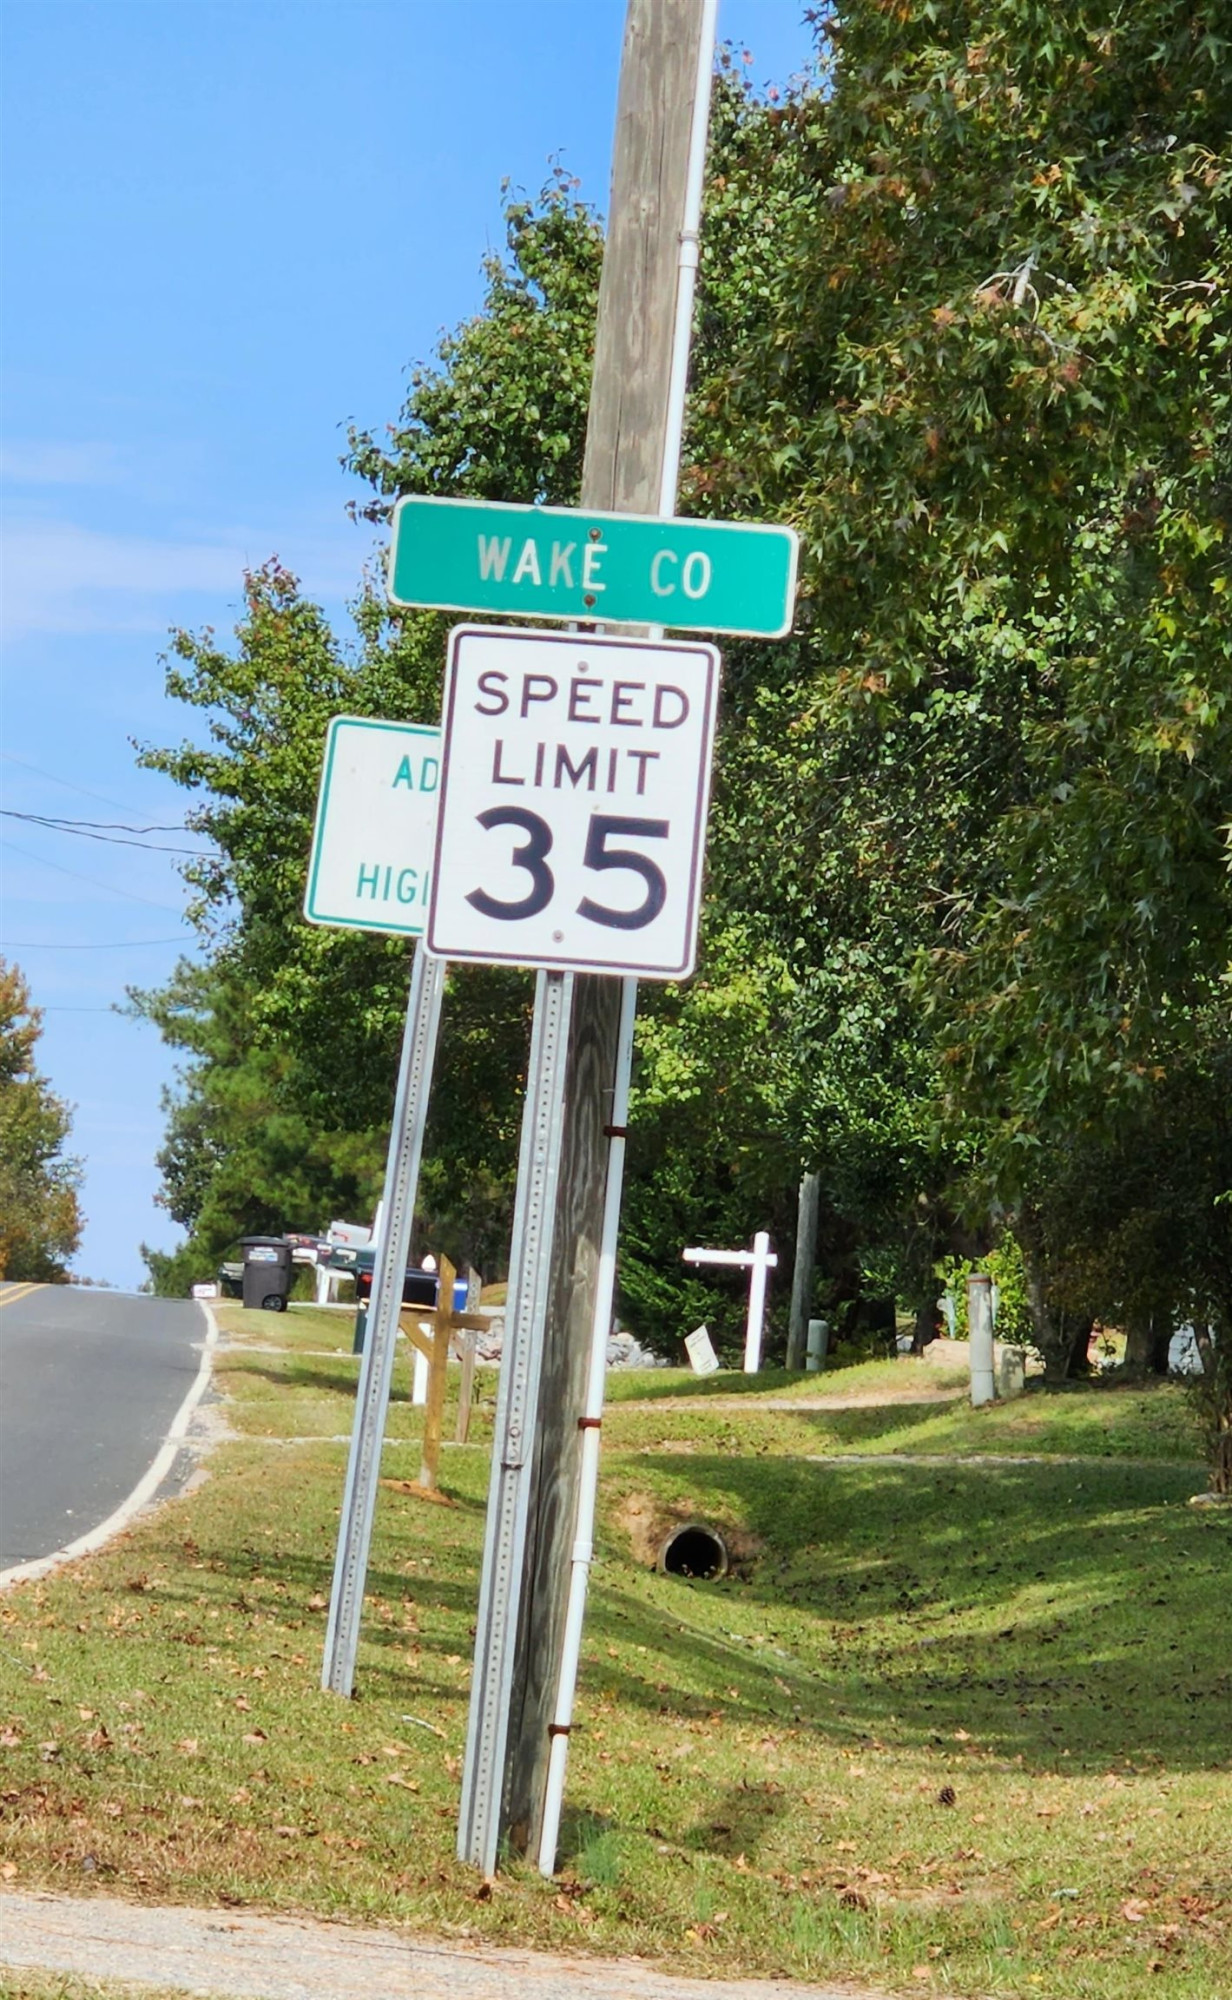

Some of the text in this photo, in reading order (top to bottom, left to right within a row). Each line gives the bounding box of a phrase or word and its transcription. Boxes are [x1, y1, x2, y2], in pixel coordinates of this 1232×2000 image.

[477, 534, 712, 599] WAKE CO
[474, 670, 690, 729] SPEED
[492, 739, 660, 795] LIMIT
[464, 805, 670, 930] 35
